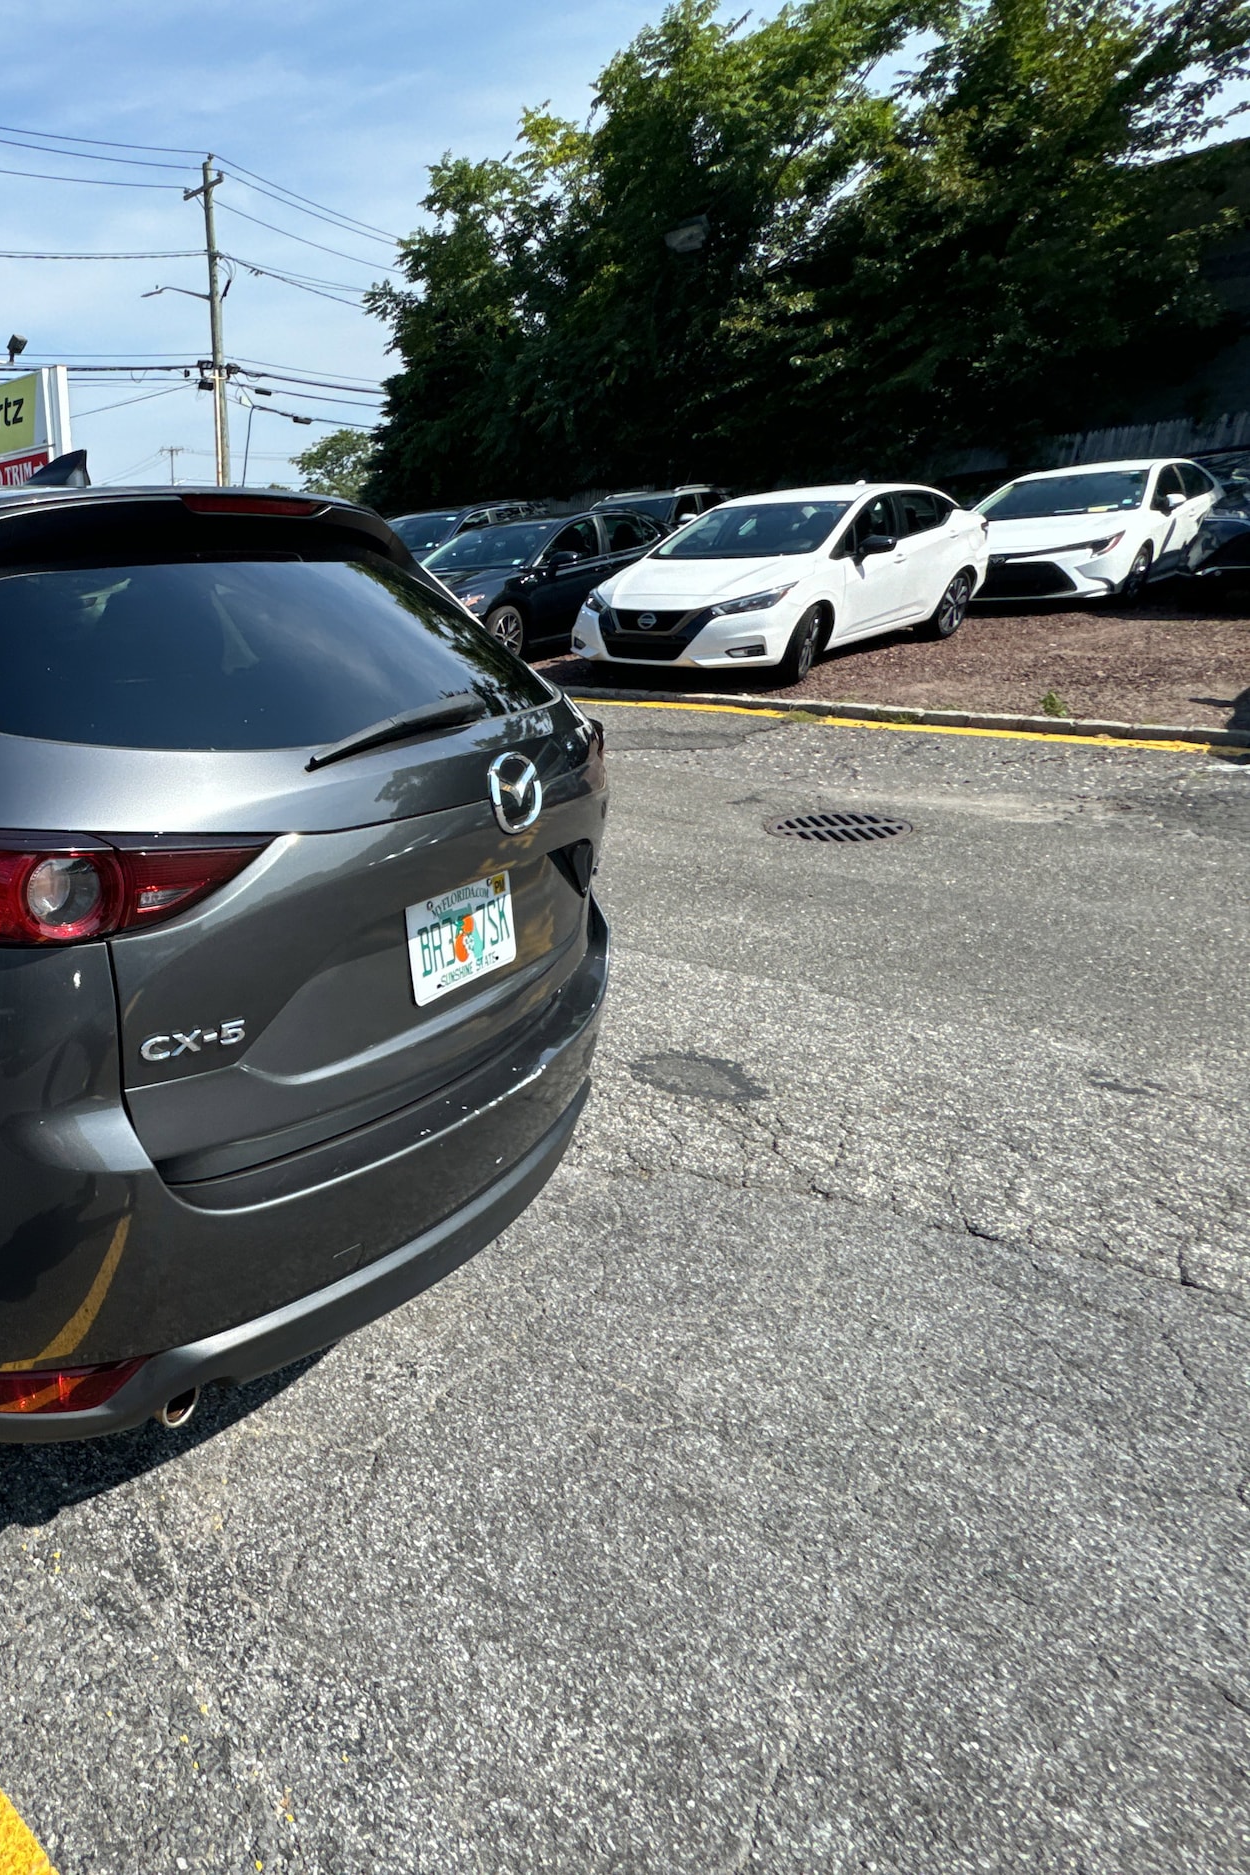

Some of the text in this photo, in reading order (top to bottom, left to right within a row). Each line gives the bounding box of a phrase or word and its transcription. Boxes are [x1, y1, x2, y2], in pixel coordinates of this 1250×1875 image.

[4, 461, 33, 487] TRIM
[440, 951, 498, 988] SUNSHINE STATE
[140, 1018, 246, 1062] CX-5
